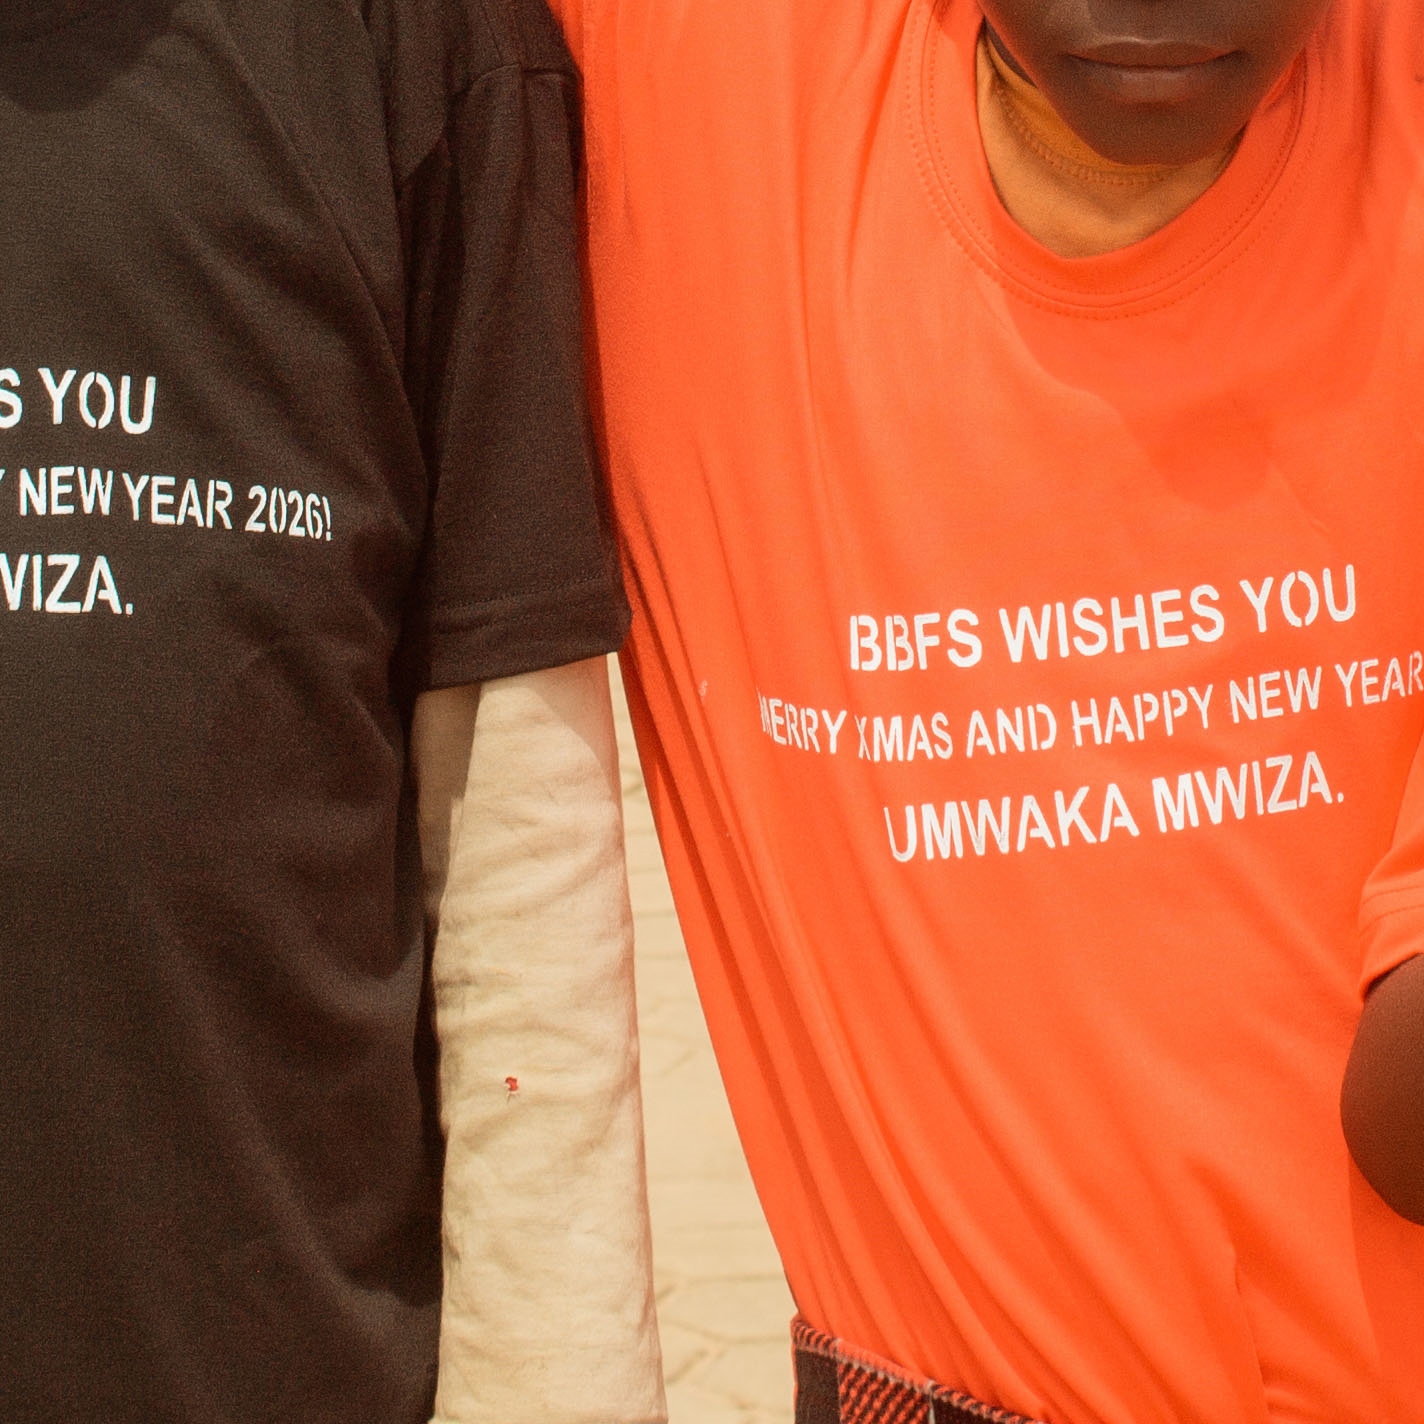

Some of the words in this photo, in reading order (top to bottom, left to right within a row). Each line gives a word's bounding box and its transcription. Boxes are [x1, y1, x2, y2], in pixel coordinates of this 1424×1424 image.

[37, 367, 156, 435] YOU
[19, 465, 114, 517] NEW
[122, 472, 233, 530] YEAR
[244, 484, 332, 542] 2026!
[849, 607, 983, 672] BBFS
[998, 583, 1225, 664] WISHES
[1238, 563, 1357, 633] YOU
[854, 711, 954, 763] XMAS
[965, 702, 1058, 759] AND
[1070, 683, 1214, 748] HAPPY
[1228, 665, 1322, 724] NEW
[1334, 650, 1424, 708] YEAR
[883, 782, 1141, 863] UMWAKA
[1151, 750, 1346, 834] MWIZA.
